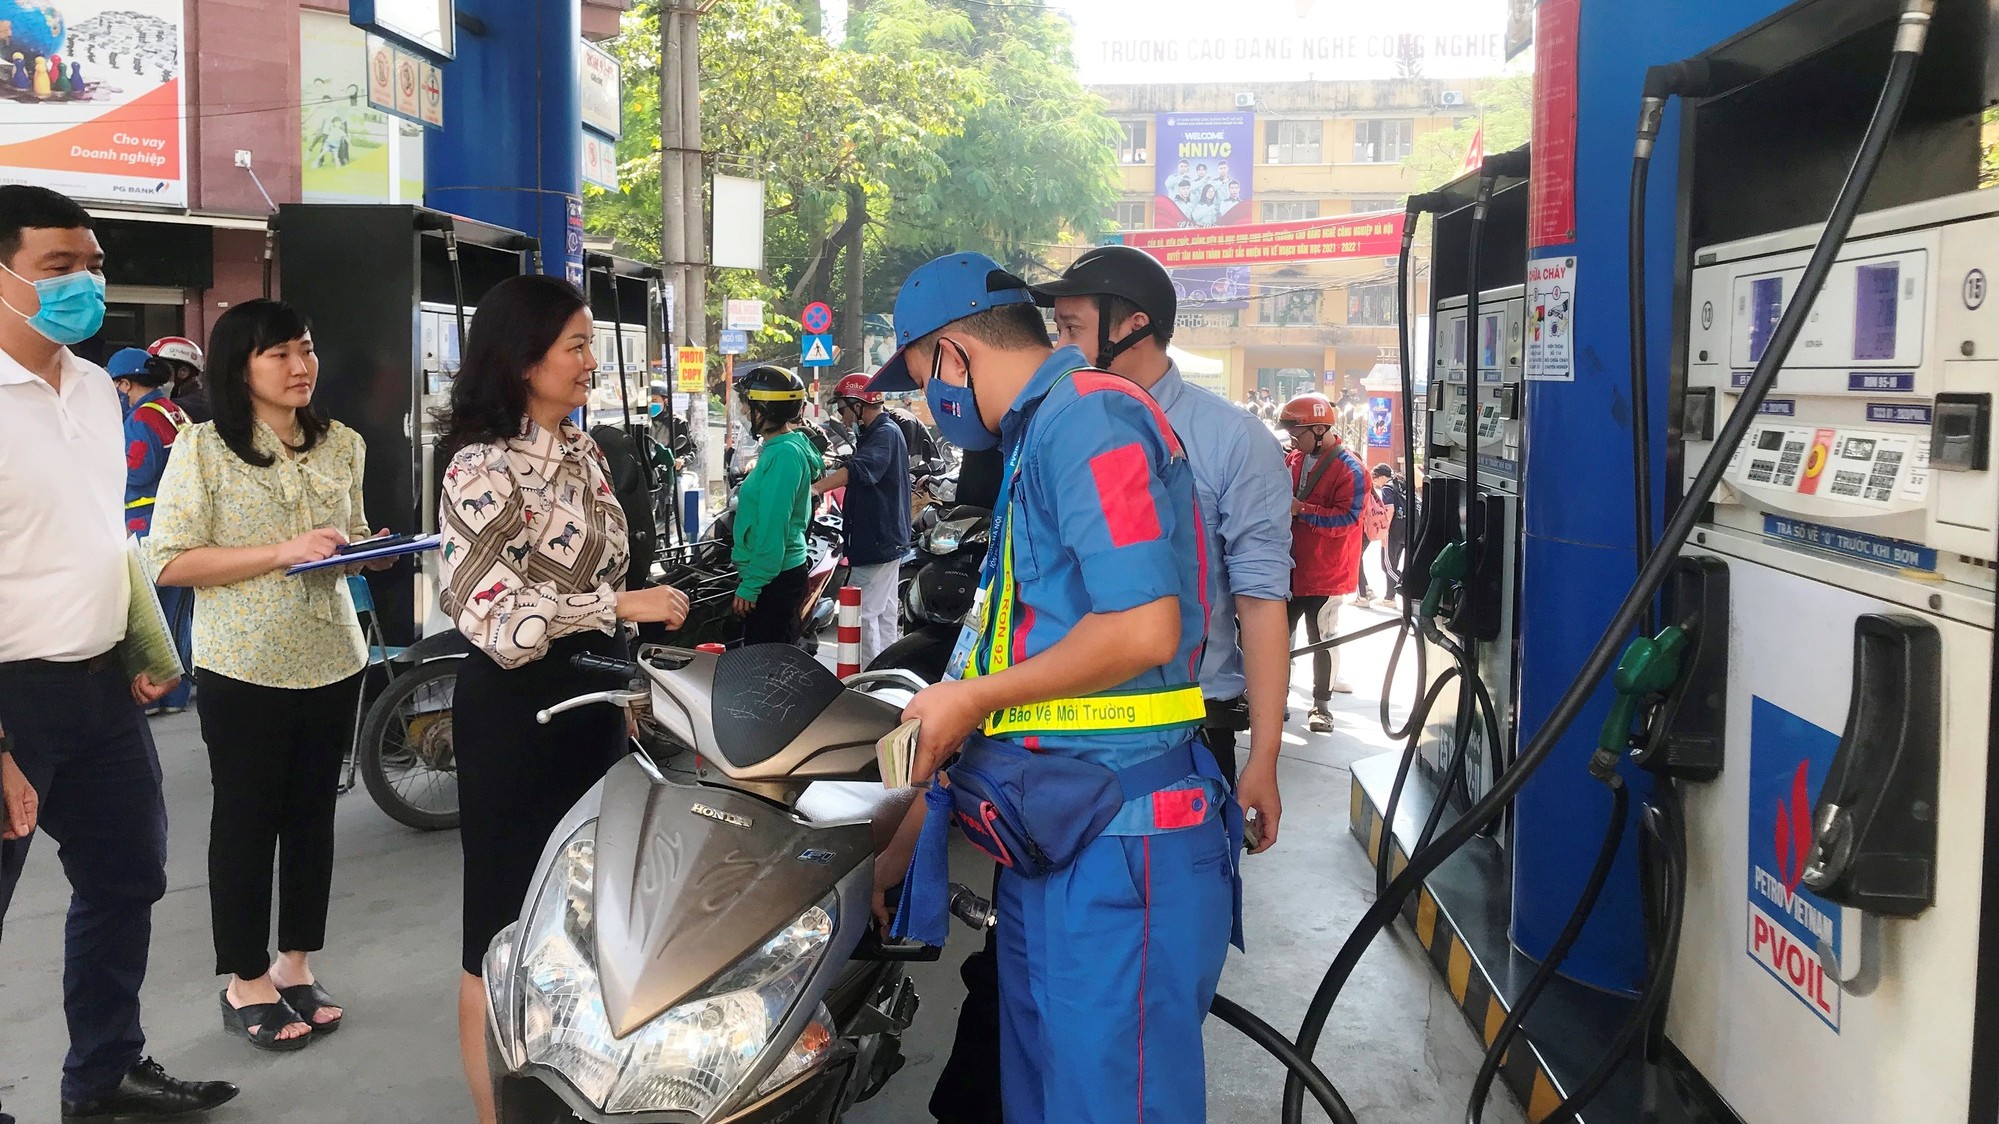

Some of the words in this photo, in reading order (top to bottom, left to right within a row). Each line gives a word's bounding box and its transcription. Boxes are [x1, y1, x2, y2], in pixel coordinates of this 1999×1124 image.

[1188, 38, 1225, 61] CAO
[113, 132, 139, 146] Cho
[141, 138, 165, 150] vay
[1184, 131, 1225, 140] WELCOME
[70, 146, 117, 161] Doanh
[119, 150, 166, 167] nghiệp
[1178, 142, 1232, 158] HNIVC
[113, 185, 126, 193] PG
[128, 186, 155, 195] BANK
[1374, 222, 1381, 235] HÀ
[1383, 222, 1393, 235] NỘI
[1322, 243, 1336, 253] 2021
[1341, 242, 1356, 252] 2022
[1543, 264, 1566, 280] CHÁY
[1968, 276, 1982, 299] 15
[680, 351, 703, 363] PHOTO
[682, 368, 702, 381] COPY
[845, 381, 864, 390] Saiko
[1776, 520, 1792, 536] TRẢ
[1793, 523, 1805, 538] SỐ
[1807, 525, 1818, 542] VỀ
[1837, 535, 1870, 554] TRƯỚC
[1872, 544, 1890, 559] KHI
[1893, 548, 1919, 566] BƠM
[997, 598, 1009, 638] RON
[993, 644, 1003, 665] 92
[1009, 704, 1032, 723] Bảo
[1036, 705, 1051, 725] Vệ
[1057, 705, 1079, 722] Môi
[1083, 703, 1136, 723] Trường
[691, 802, 751, 829] HONDA
[1754, 864, 1834, 948] PETROVIETNAM
[1754, 913, 1832, 1015] PVOIL
